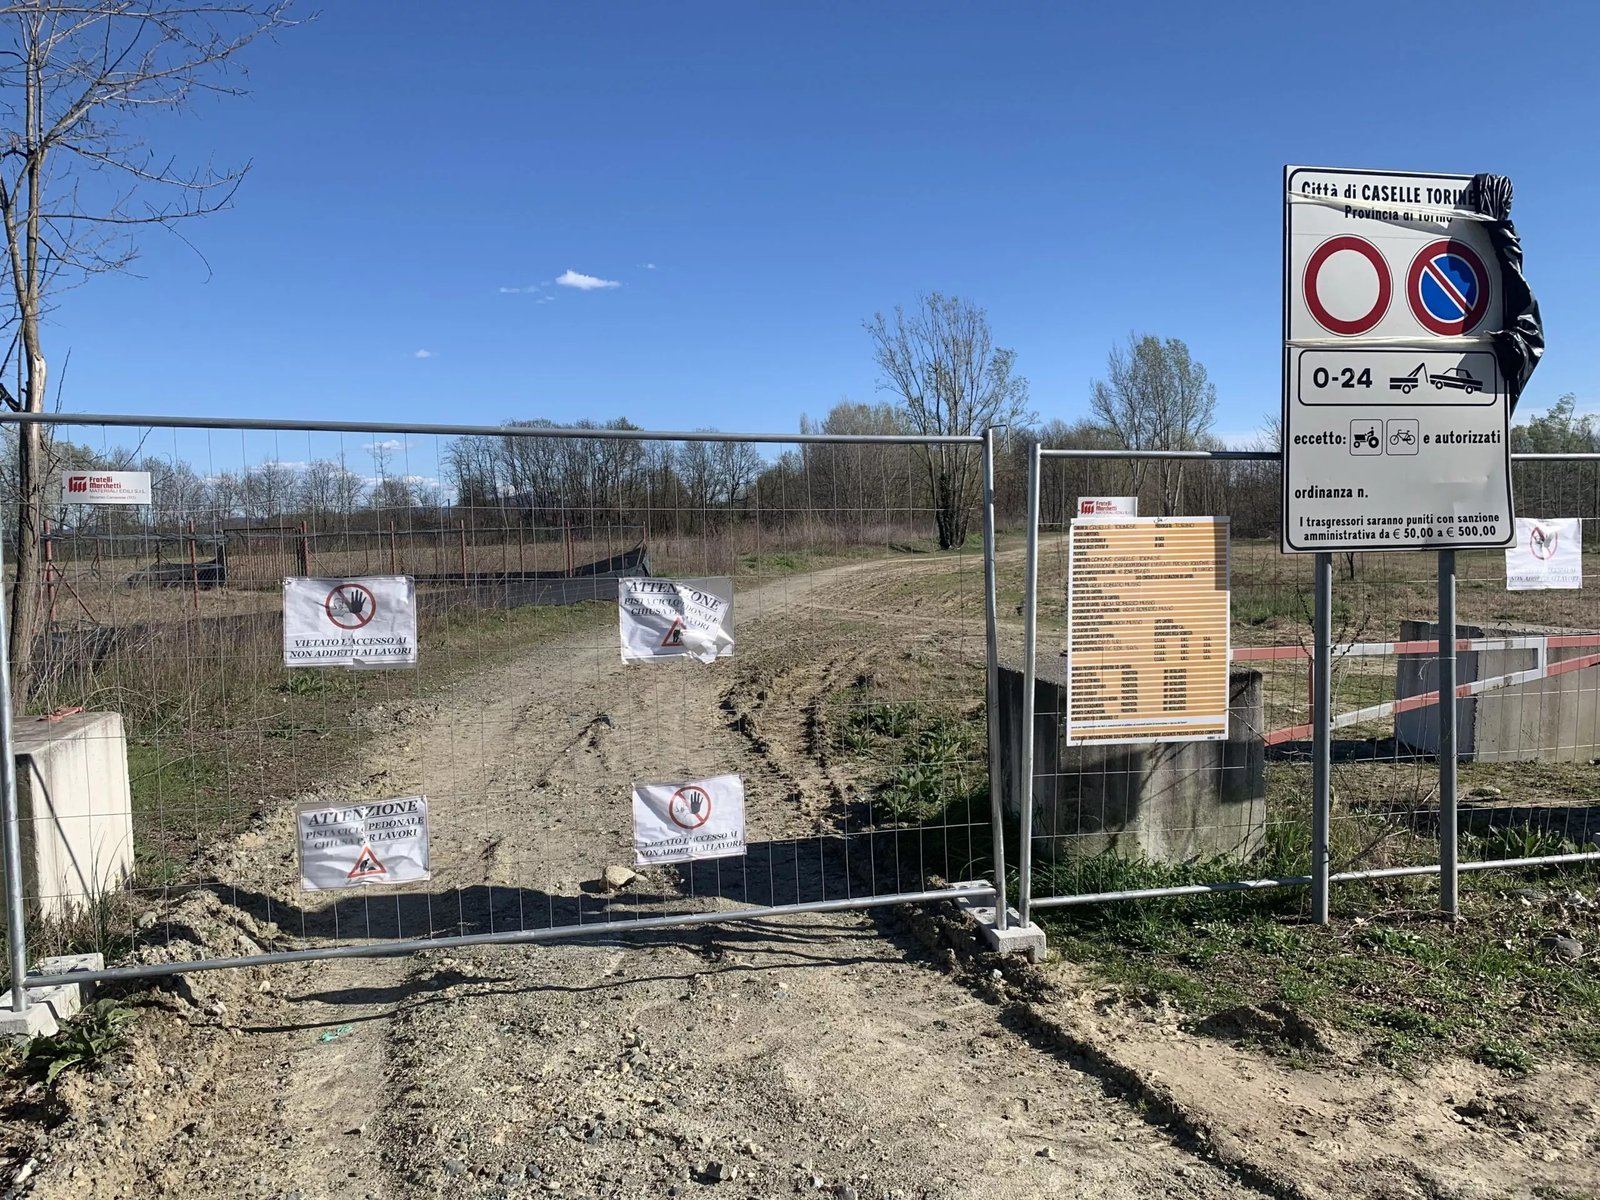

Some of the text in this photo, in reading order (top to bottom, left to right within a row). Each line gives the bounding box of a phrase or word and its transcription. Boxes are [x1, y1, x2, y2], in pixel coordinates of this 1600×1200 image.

[1302, 181, 1476, 207] Città di CASELLE TORINE
[1344, 205, 1399, 219] Provincia
[1312, 367, 1373, 388] 0-24
[1294, 429, 1501, 445] eccetto: e autorizzati
[1295, 485, 1369, 499] ordinanza n.
[1306, 515, 1364, 530] trasgressori
[1366, 515, 1404, 526] saranno
[1406, 514, 1434, 527] puniti
[1437, 515, 1454, 524] con
[1457, 512, 1500, 524] sanzione
[1303, 529, 1376, 541] amministrativa
[1378, 528, 1390, 539] da
[1392, 528, 1401, 539] €
[1437, 529, 1444, 538] a
[1446, 527, 1454, 538] €
[295, 636, 407, 647] VIETATO L'ACCESSO AI
[290, 650, 312, 658] NON
[314, 649, 359, 657] ADDETTI
[374, 647, 412, 655] LAVORI
[308, 799, 419, 826] ATTENZIONE
[306, 829, 336, 840] PISTA
[368, 816, 425, 830] PEDONALE
[378, 828, 418, 841] LAVORI
[640, 849, 658, 857] NON
